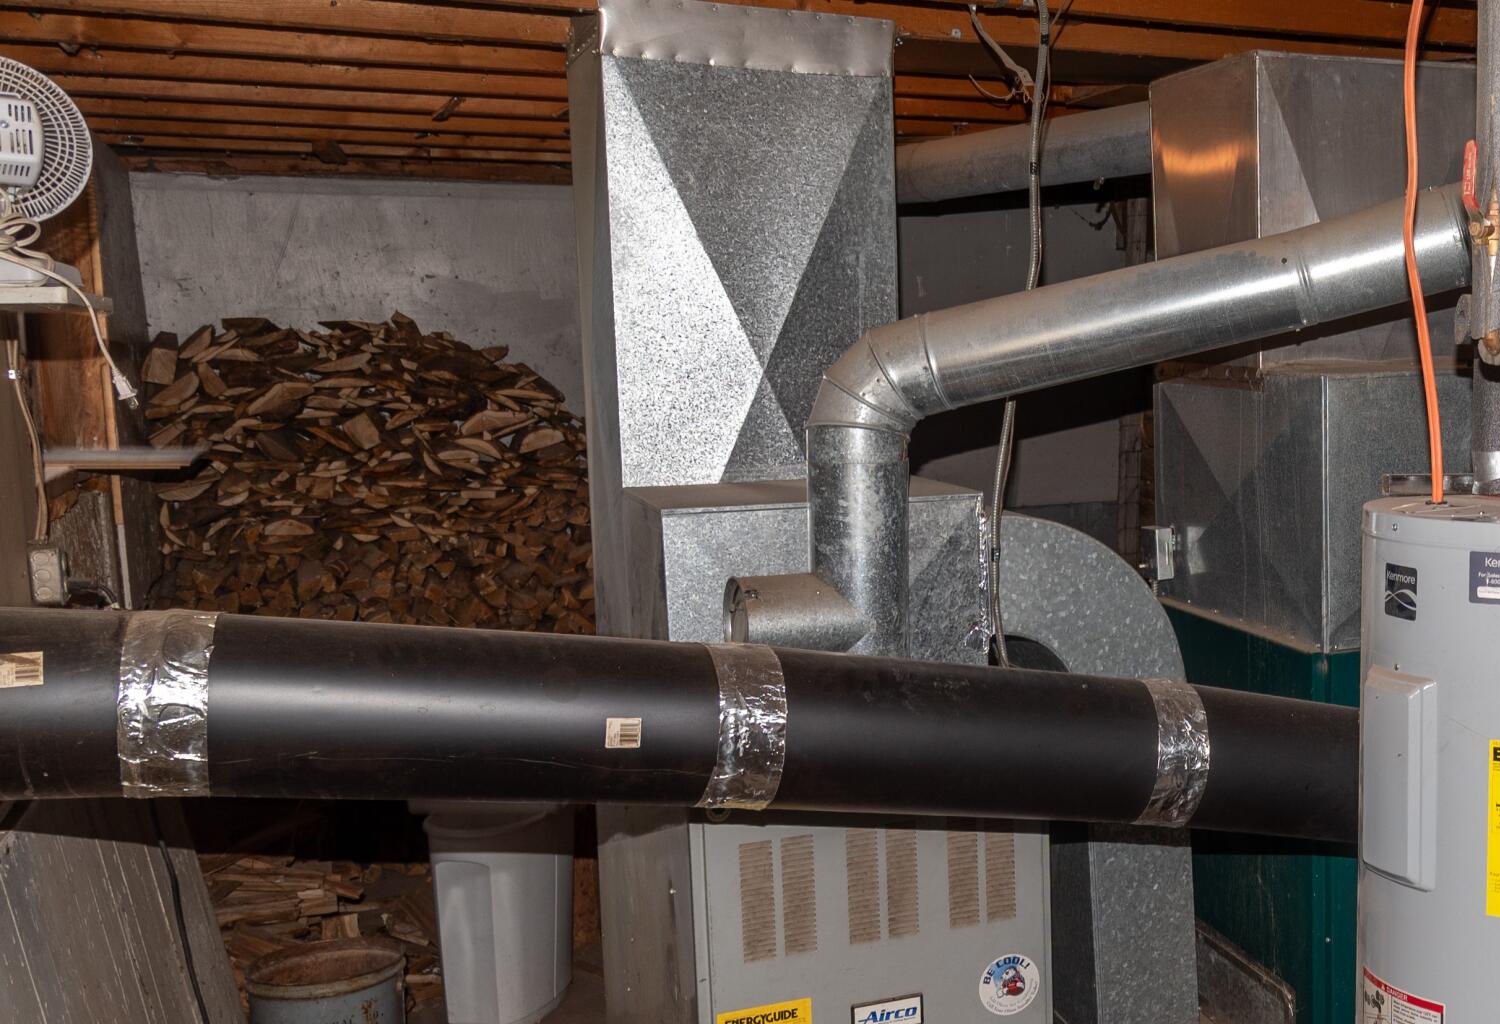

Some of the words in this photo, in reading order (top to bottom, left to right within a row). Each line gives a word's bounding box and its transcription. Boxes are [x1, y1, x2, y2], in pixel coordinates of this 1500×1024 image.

[1386, 570, 1415, 584] Kenmore
[983, 968, 995, 984] BE
[996, 956, 1030, 969] COOL!
[858, 1007, 918, 1024] Airco
